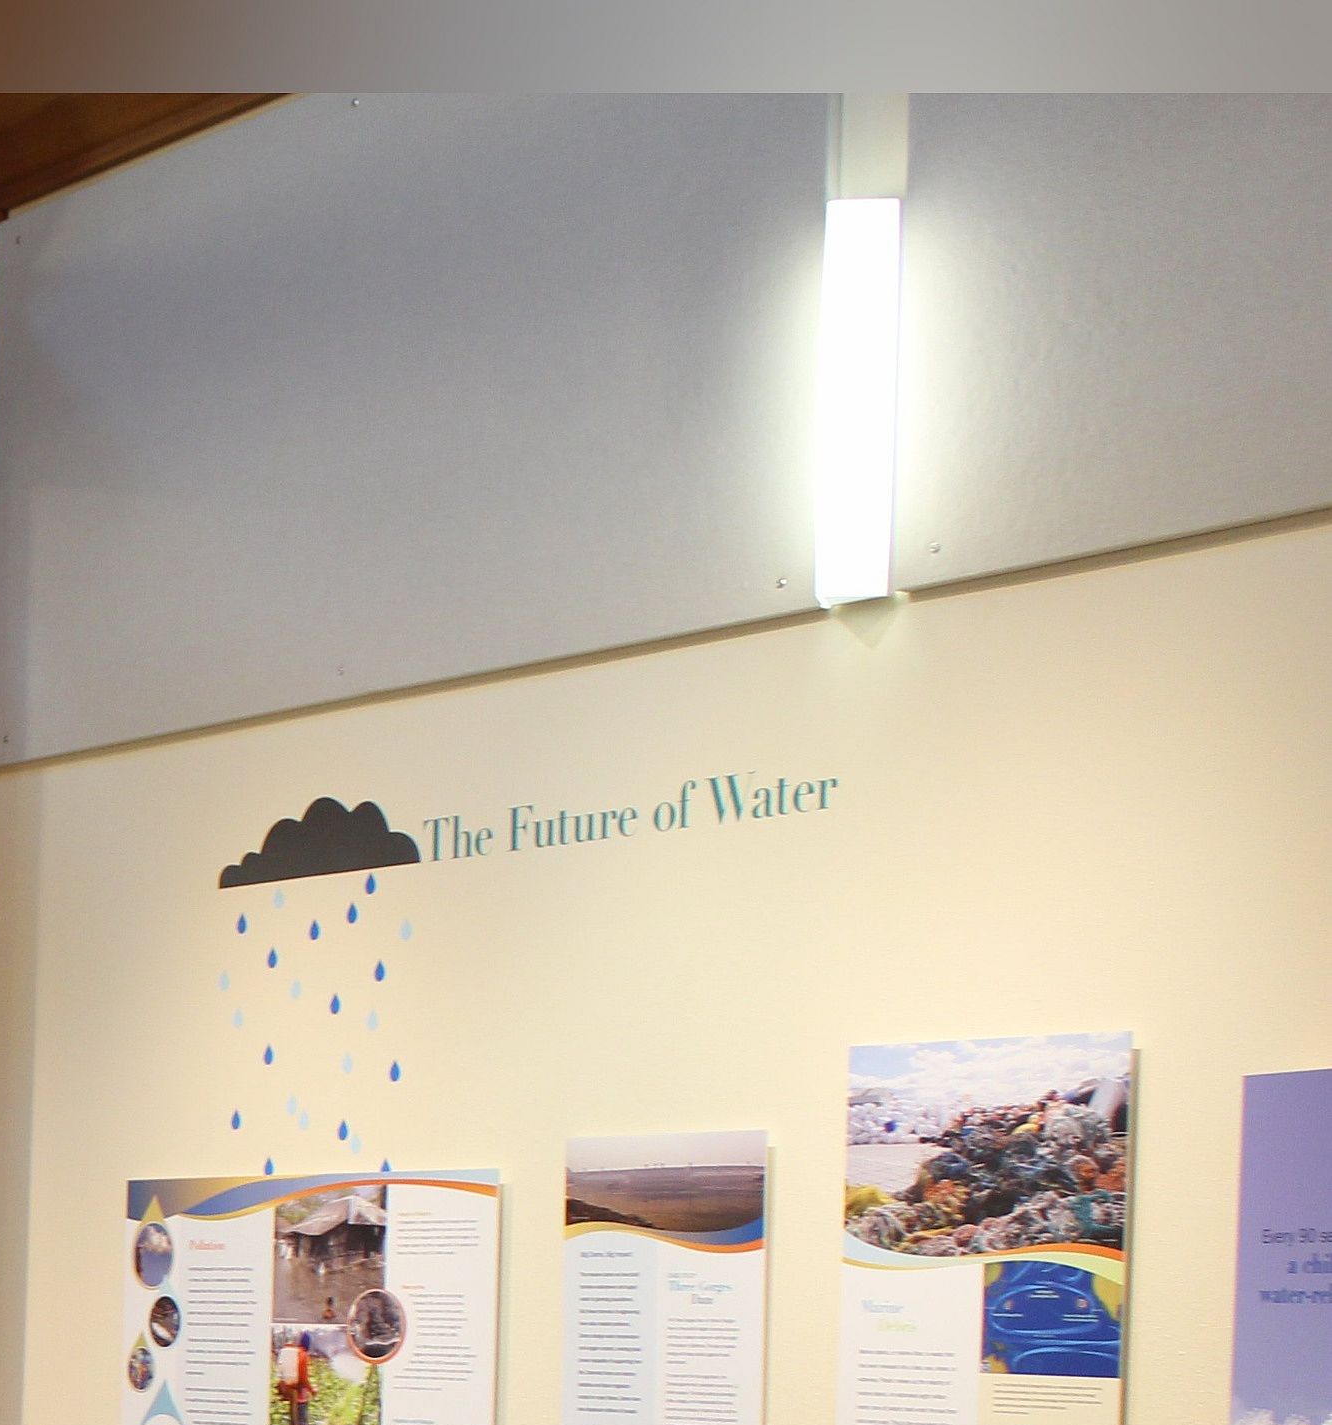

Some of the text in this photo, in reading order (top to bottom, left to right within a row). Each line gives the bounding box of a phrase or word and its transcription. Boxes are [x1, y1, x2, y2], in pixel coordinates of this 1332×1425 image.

[424, 770, 839, 862] The Future of Water
[1261, 1228, 1294, 1247] Every
[1298, 1228, 1316, 1243] 90
[1287, 1260, 1298, 1274] a
